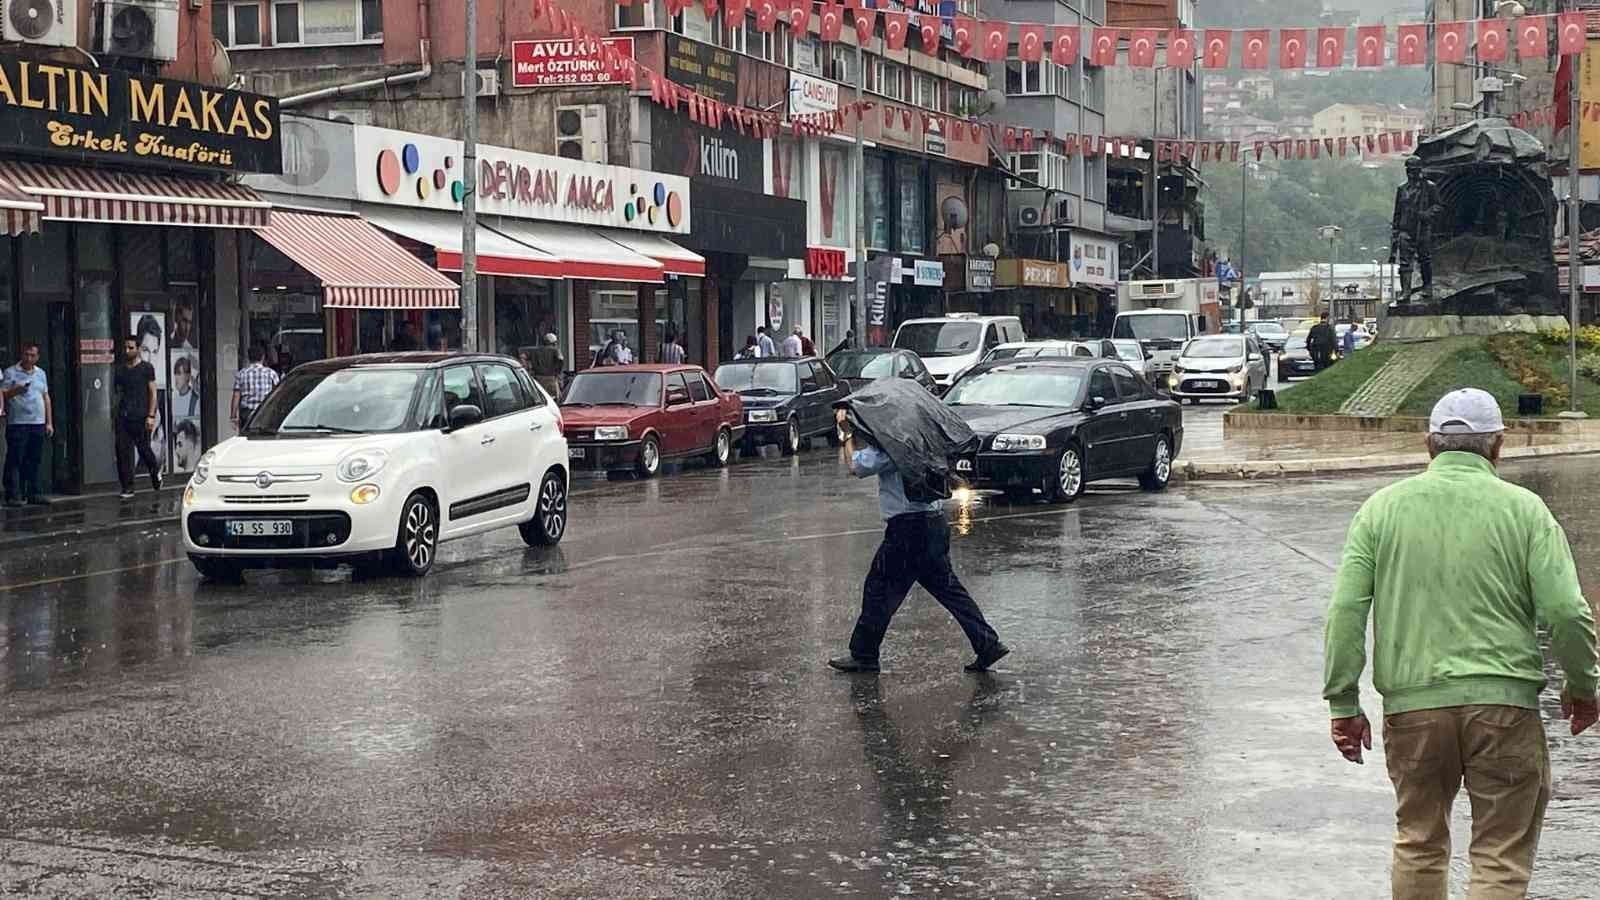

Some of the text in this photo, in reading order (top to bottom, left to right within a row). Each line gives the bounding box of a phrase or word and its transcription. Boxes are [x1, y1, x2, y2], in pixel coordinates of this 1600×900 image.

[517, 62, 544, 73] Mert
[580, 73, 593, 82] 03
[0, 61, 273, 140] ALTIN MAKAS
[47, 120, 233, 165] Erkek Kuaförü
[700, 135, 738, 180] kilim
[479, 158, 614, 212] DEVRAN AMCA
[252, 522, 265, 534] SS
[272, 522, 291, 534] 930
